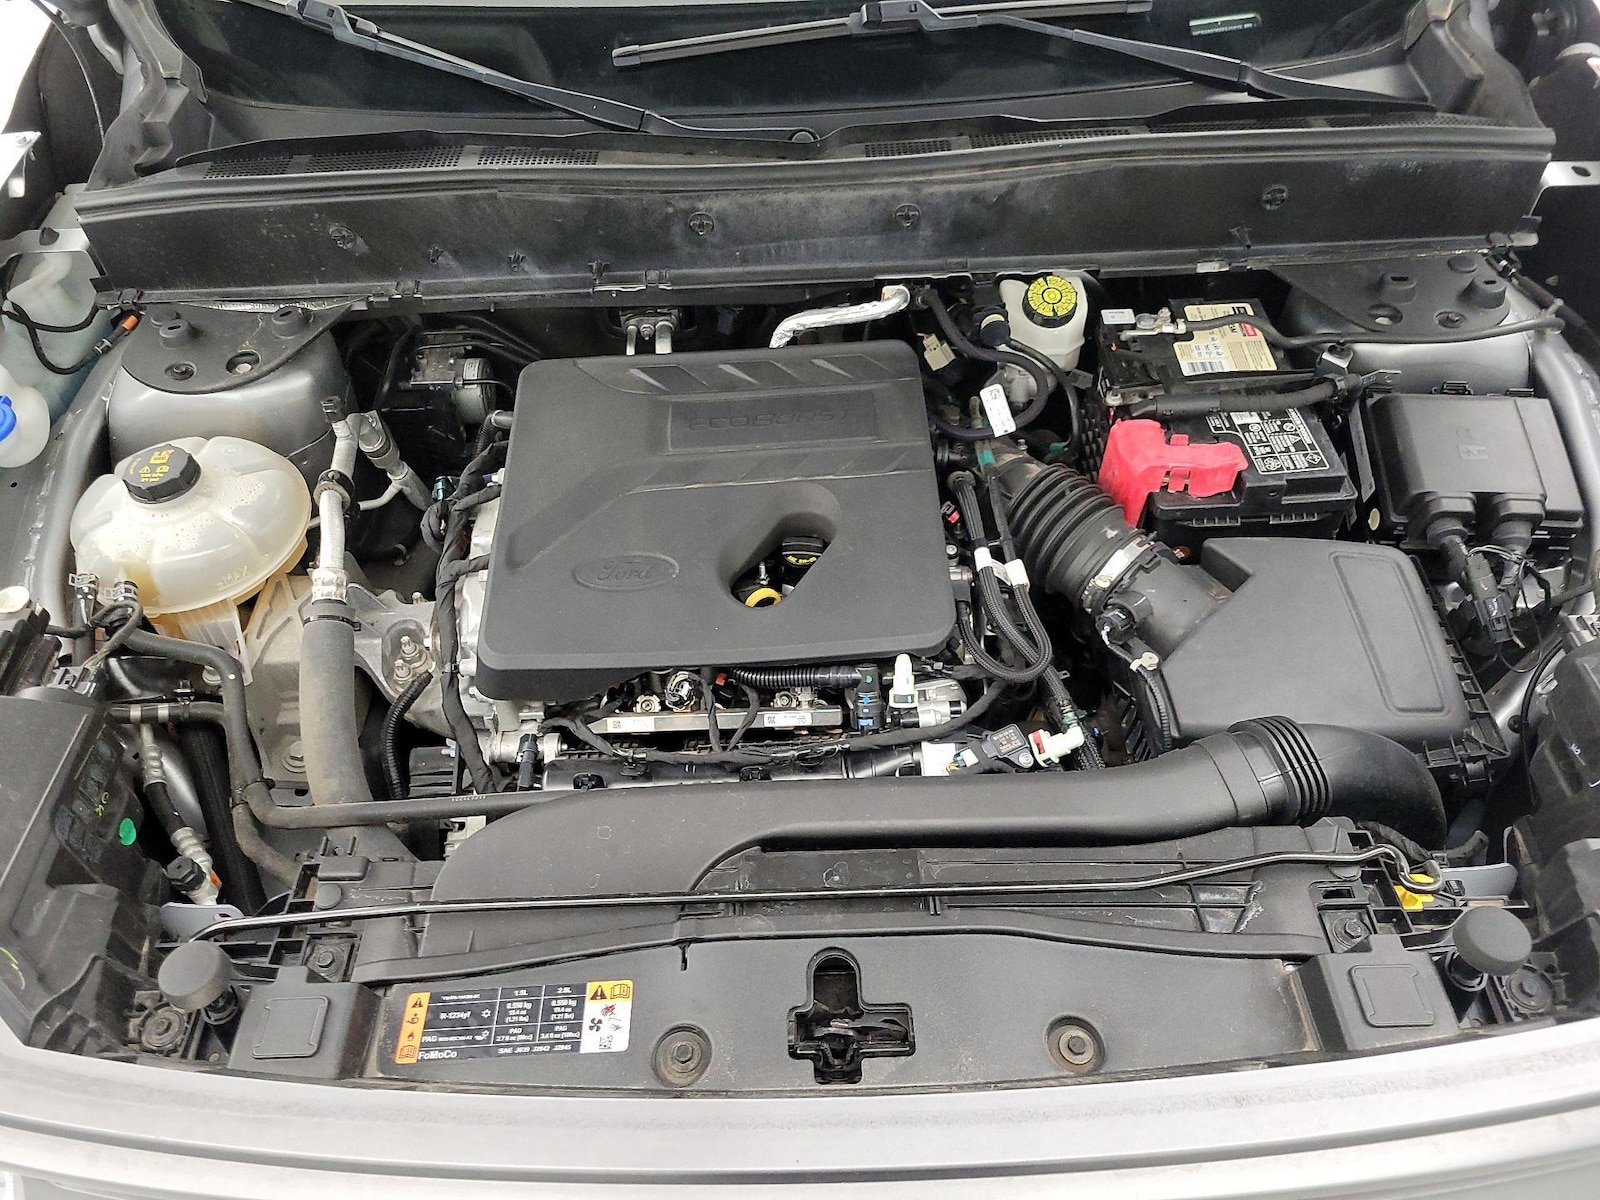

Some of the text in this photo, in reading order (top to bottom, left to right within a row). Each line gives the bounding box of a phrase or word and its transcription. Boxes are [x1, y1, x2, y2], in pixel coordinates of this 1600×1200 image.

[596, 560, 654, 582] Ford
[439, 1010, 471, 1019] R-1234yf
[418, 1050, 457, 1060] FoMoCo
